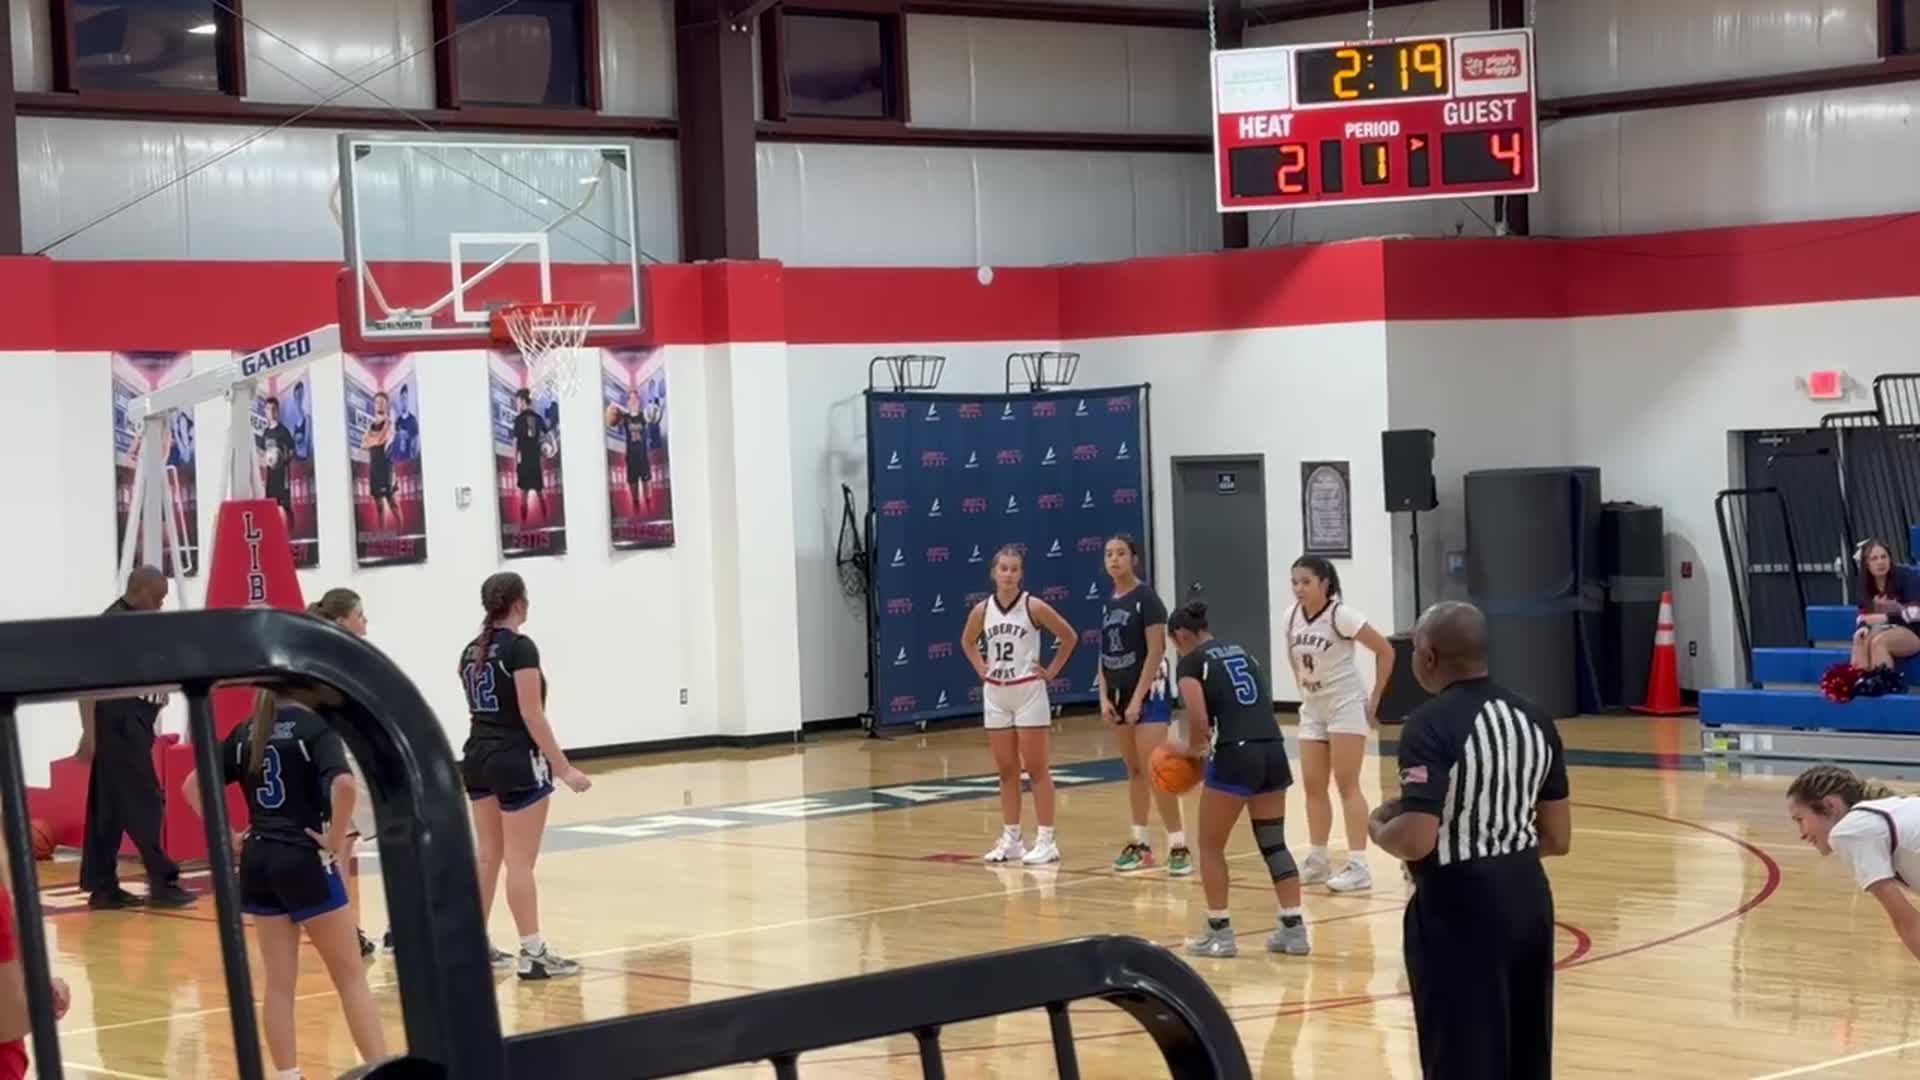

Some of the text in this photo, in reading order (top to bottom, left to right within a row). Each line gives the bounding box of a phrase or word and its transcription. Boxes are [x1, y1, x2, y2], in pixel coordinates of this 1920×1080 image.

[1333, 43, 1443, 99] 2:19
[1239, 113, 1294, 139] HEAT
[1345, 121, 1400, 139] PERIOD
[1443, 99, 1517, 125] GUEST
[1278, 144, 1305, 193] 2
[1377, 145, 1387, 179] 1
[1491, 132, 1521, 176] 4
[241, 335, 311, 377] GARED
[243, 511, 266, 606] LIB
[994, 641, 1015, 662] 12
[463, 661, 500, 713] 12
[1223, 656, 1259, 705] 5
[256, 744, 286, 809] 3
